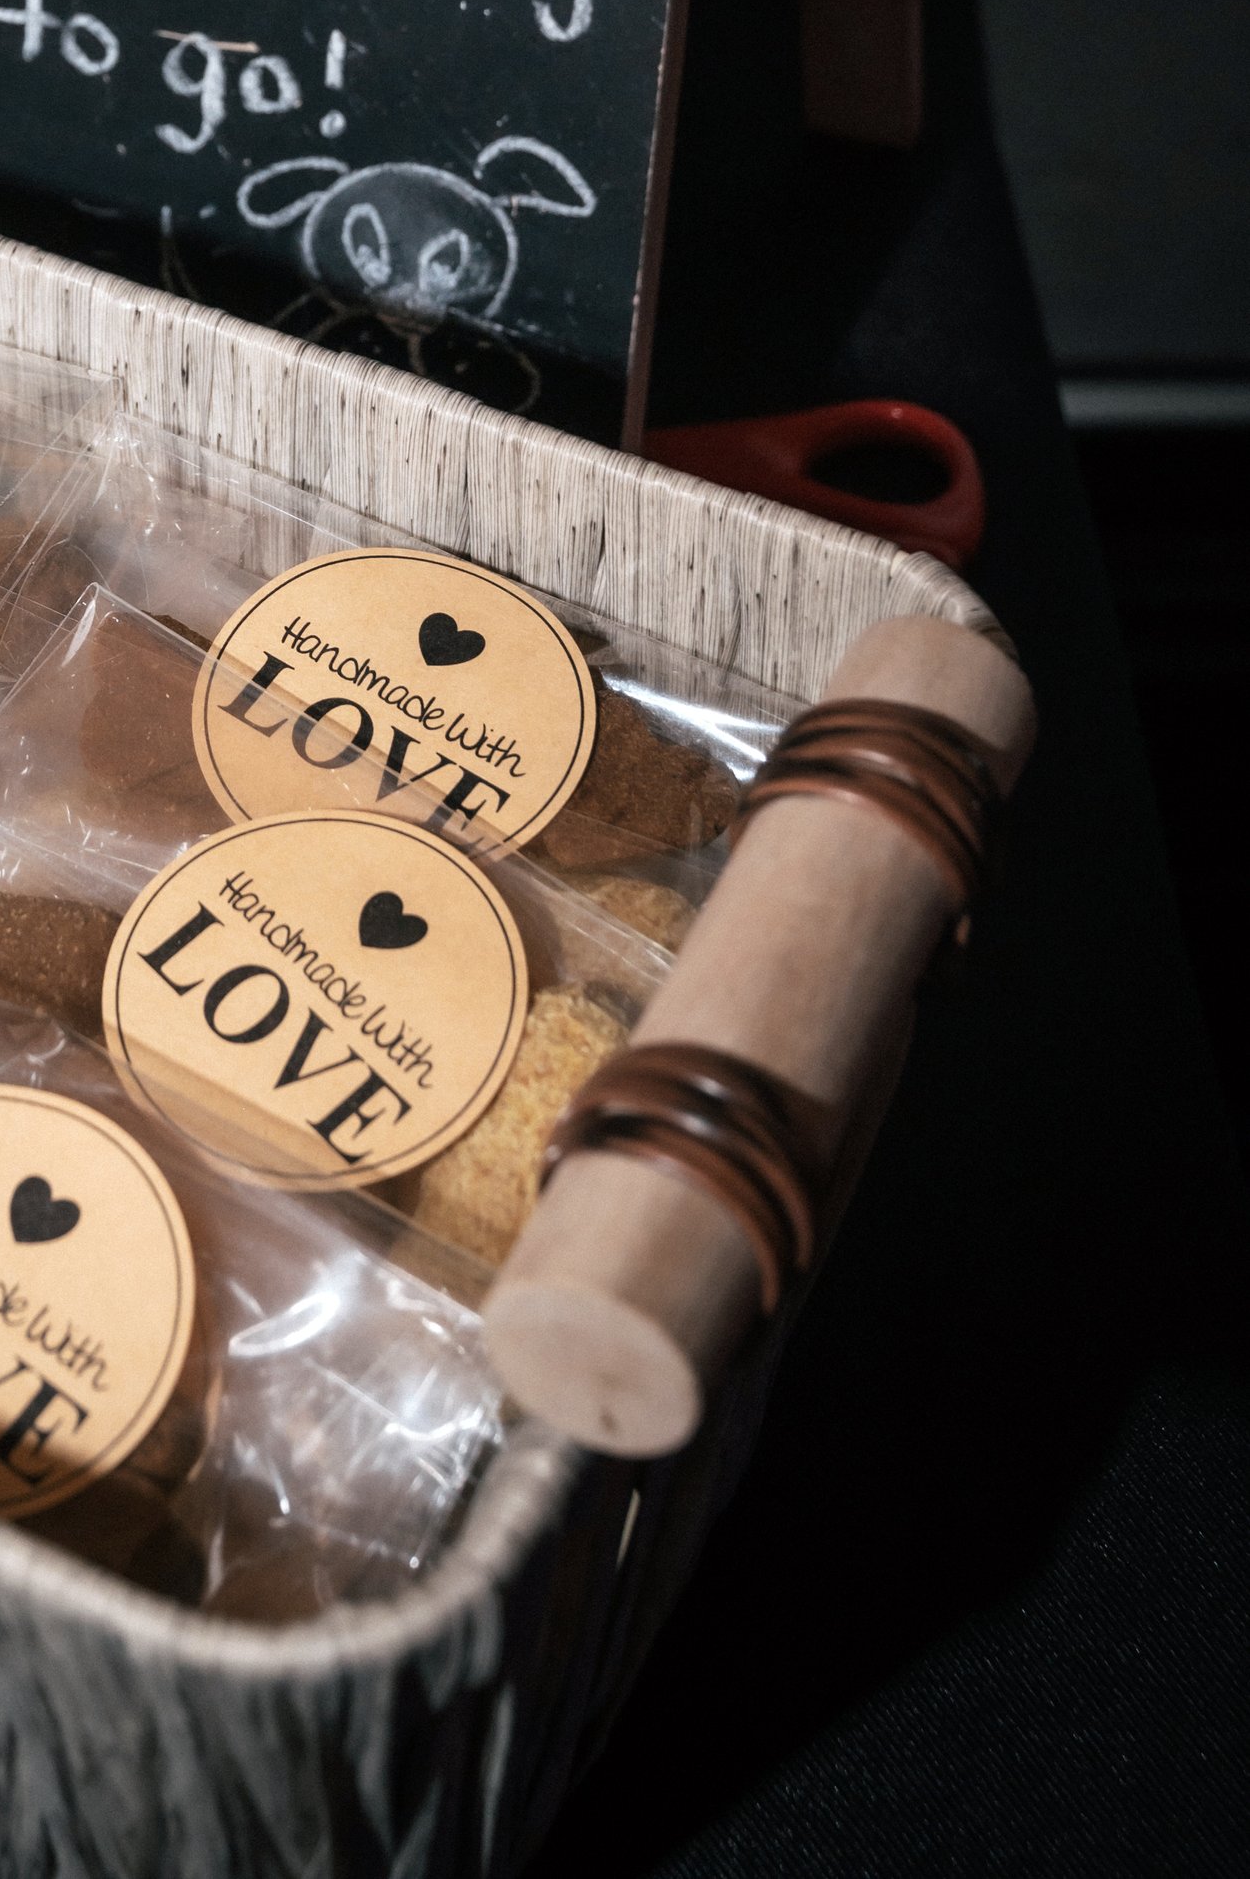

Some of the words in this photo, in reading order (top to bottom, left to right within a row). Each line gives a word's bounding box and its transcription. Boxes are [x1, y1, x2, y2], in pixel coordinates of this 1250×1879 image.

[155, 28, 347, 154] go!
[217, 651, 511, 857] LOVE
[281, 616, 446, 730] Handmade
[445, 713, 526, 778] With
[137, 900, 412, 1165] LOVE
[219, 871, 367, 1020] Handmade
[361, 1005, 434, 1089] With
[26, 1306, 109, 1392] With
